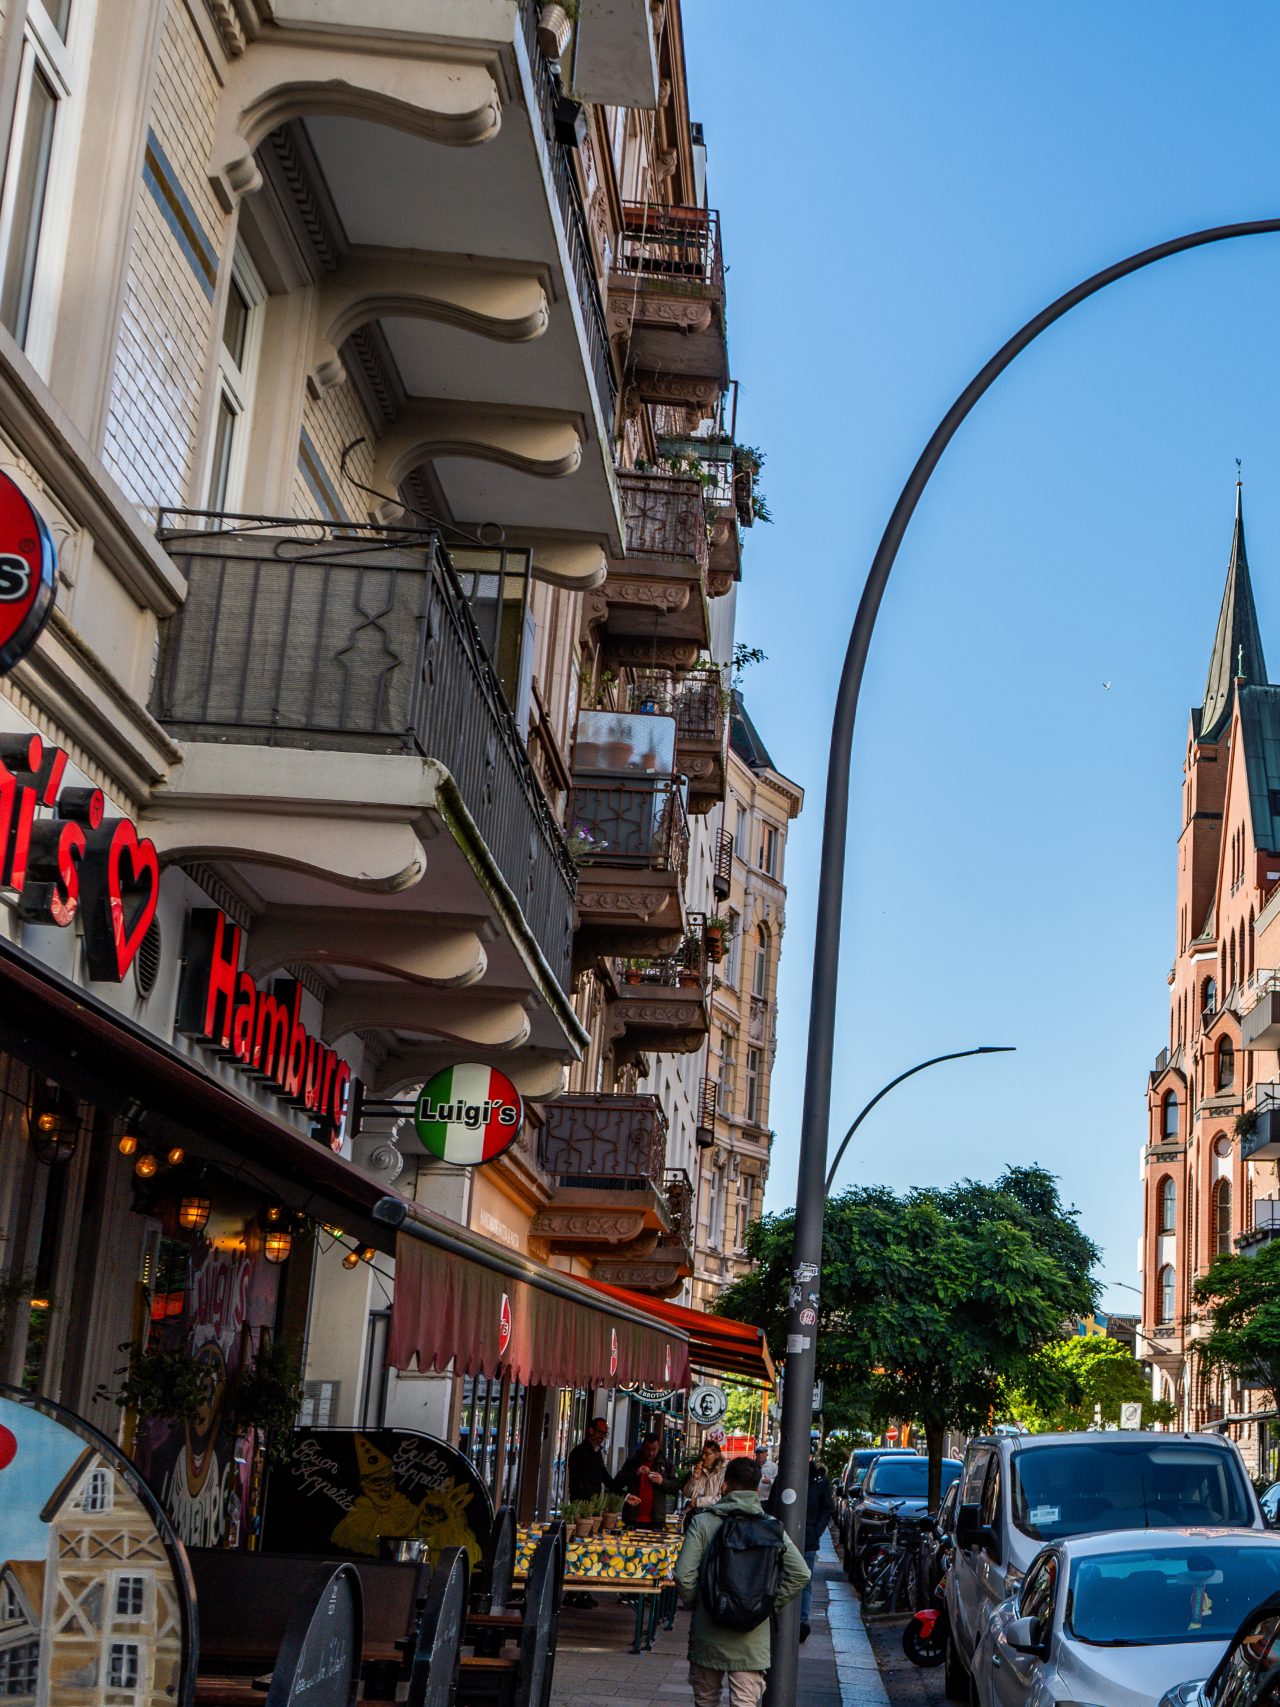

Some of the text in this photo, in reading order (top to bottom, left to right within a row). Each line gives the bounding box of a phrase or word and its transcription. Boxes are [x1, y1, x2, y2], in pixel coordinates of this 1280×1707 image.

[203, 910, 352, 1153] Hamburg
[292, 1438, 339, 1474] Buon
[393, 1438, 449, 1474] Guten
[291, 1462, 354, 1512] Appetito
